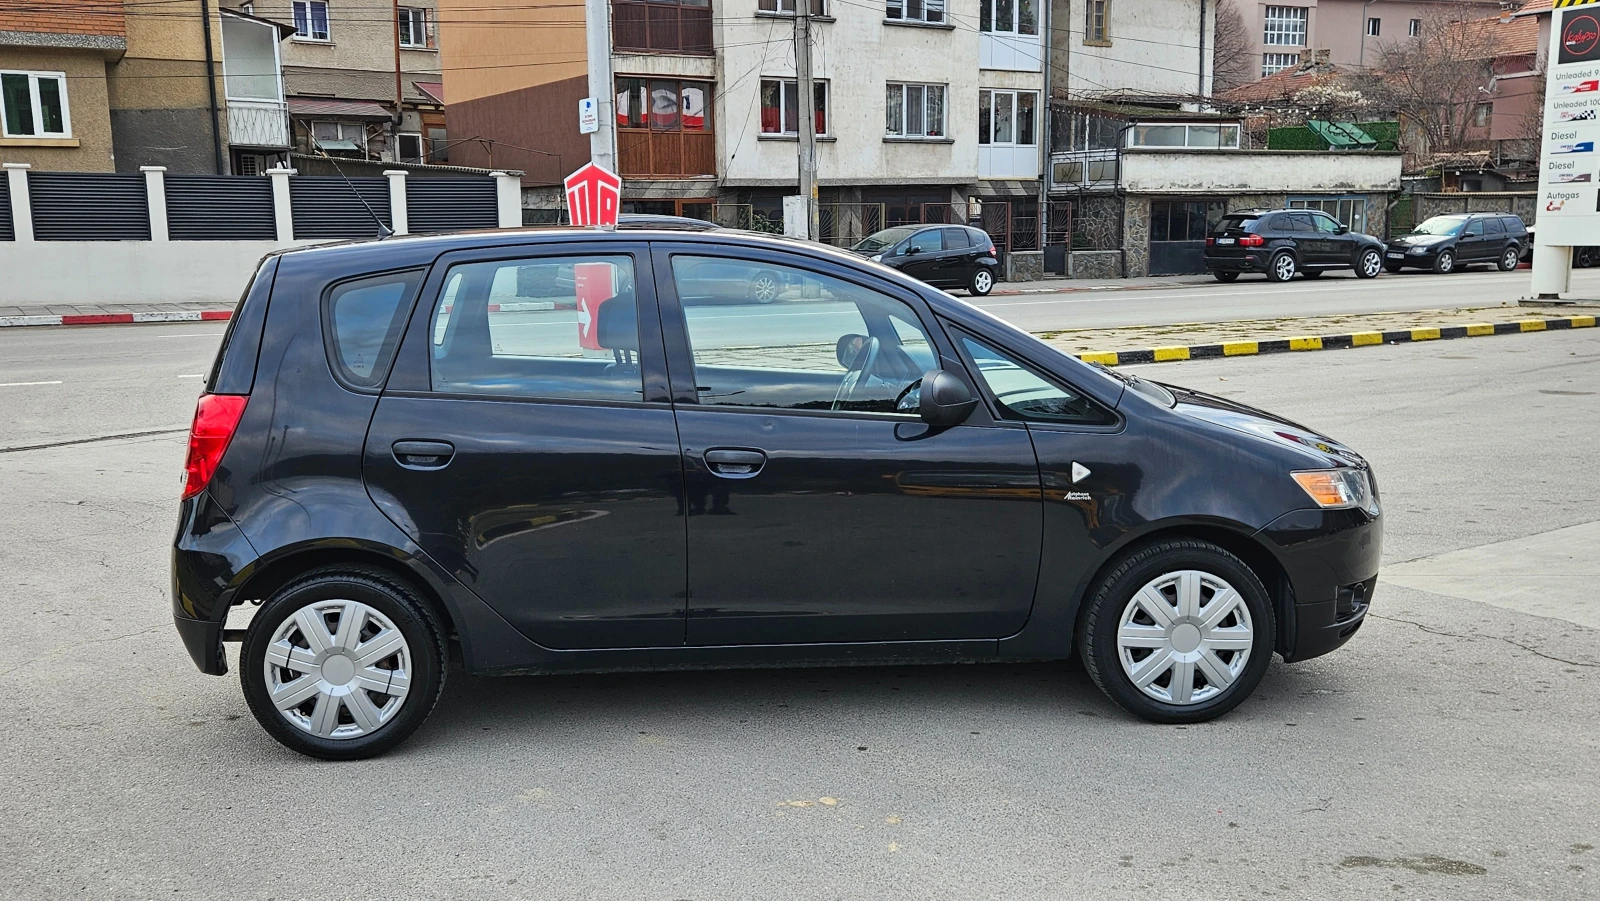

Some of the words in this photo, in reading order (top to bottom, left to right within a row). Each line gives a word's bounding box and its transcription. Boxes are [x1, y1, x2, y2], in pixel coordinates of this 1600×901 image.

[1556, 70, 1592, 80] Unleaded
[1554, 100, 1587, 109] Unleaded
[1551, 131, 1577, 140] Diesel
[1549, 161, 1575, 169] Diesel
[1546, 192, 1580, 200] Autogas
